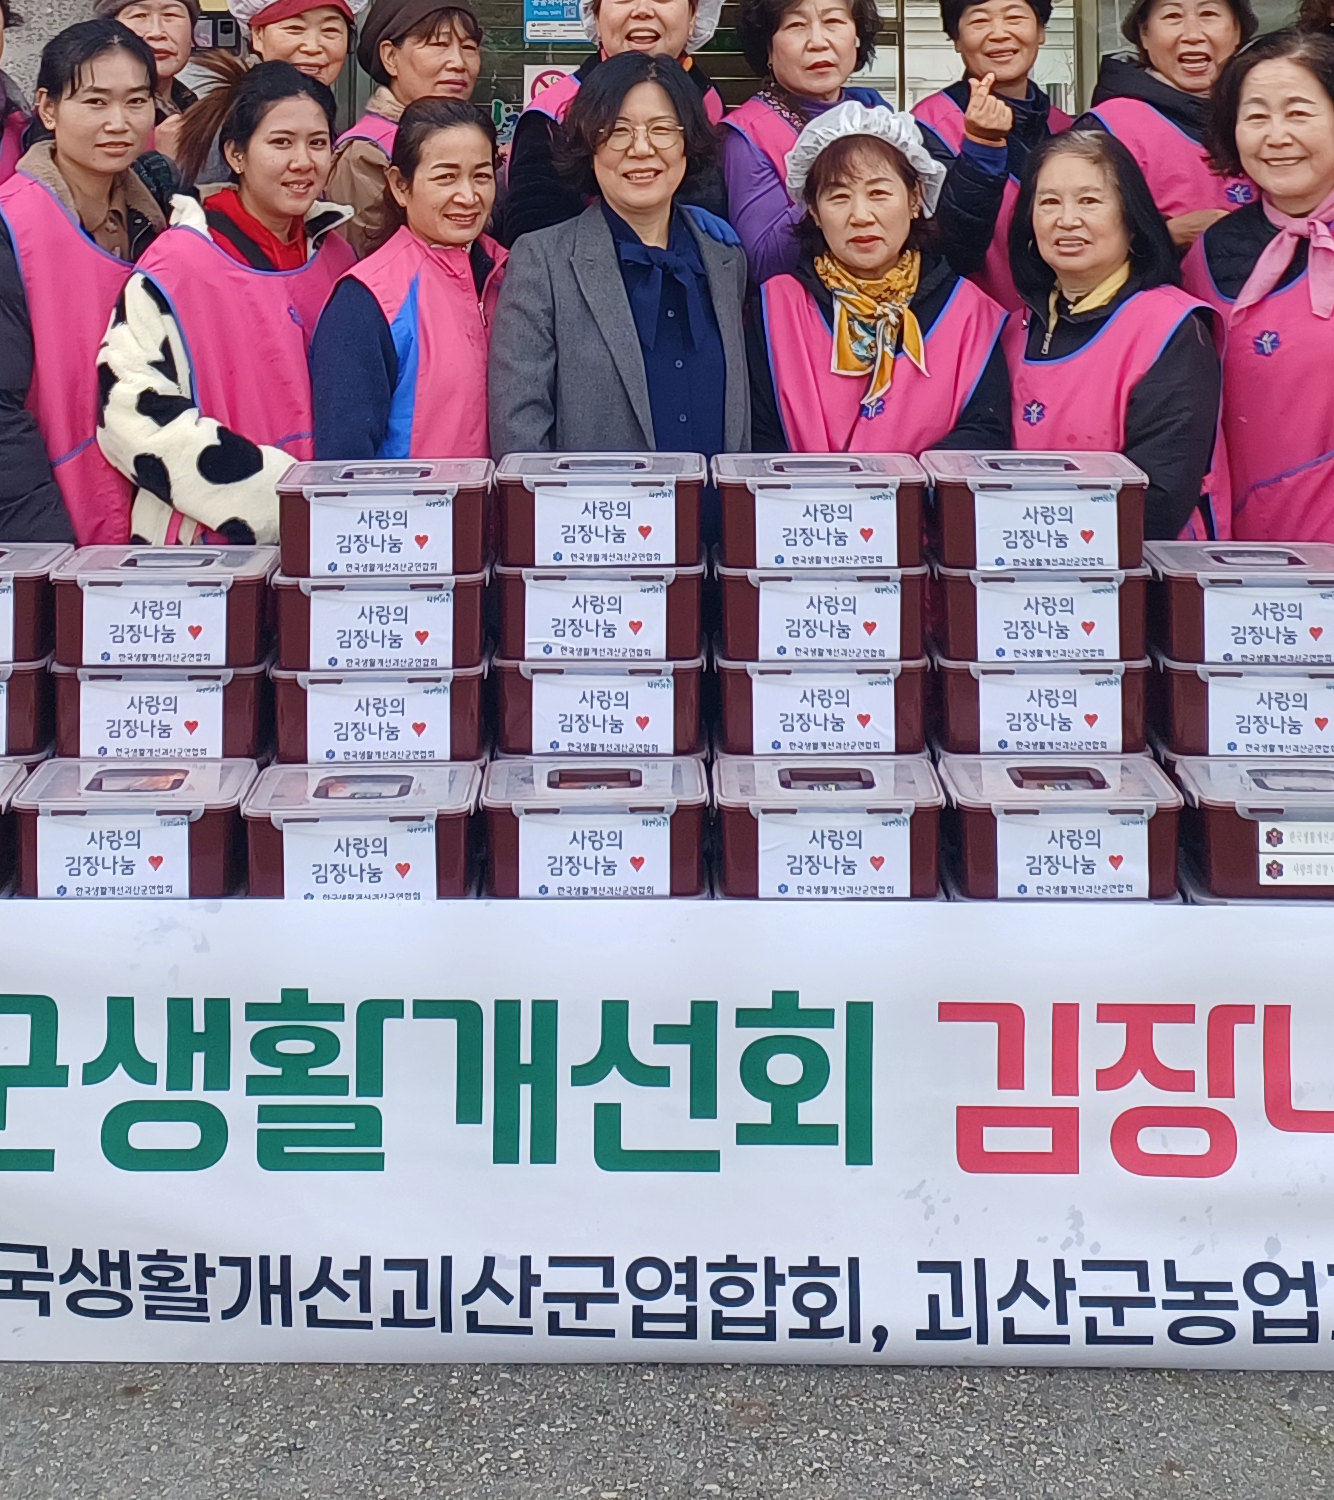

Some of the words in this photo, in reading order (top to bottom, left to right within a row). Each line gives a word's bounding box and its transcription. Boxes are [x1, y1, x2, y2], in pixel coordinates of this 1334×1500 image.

[357, 509, 408, 530] 사랑의
[581, 500, 631, 521] 사랑의
[802, 503, 853, 524] 사랑의
[1022, 505, 1074, 526] 사랑의
[335, 533, 404, 555] 김장나눔
[560, 524, 627, 545] 김장나눔
[782, 526, 849, 547] 김장나눔
[1002, 529, 1070, 550] 김장나눔
[129, 599, 182, 621] 사랑의
[357, 604, 409, 626] 사랑의
[571, 594, 622, 615] 사랑의
[805, 594, 857, 616] 사랑의
[1023, 596, 1075, 617] 사랑의
[1251, 602, 1303, 622] 사랑의
[109, 623, 177, 644] 김장나눔
[551, 617, 618, 639] 김장나눔
[785, 618, 852, 640] 김장나눔
[1003, 620, 1071, 641] 김장나눔
[1230, 625, 1298, 646] 김장나눔
[336, 629, 404, 650] 김장나눔
[126, 695, 178, 716] 사랑의
[354, 697, 405, 718] 사랑의
[578, 689, 629, 711] 사랑의
[799, 688, 850, 709] 사랑의
[1026, 688, 1078, 709] 사랑의
[1256, 691, 1308, 712] 사랑의
[105, 718, 173, 739] 김장나눔
[333, 721, 401, 742] 김장나눔
[558, 713, 625, 734] 김장나눔
[779, 712, 846, 733] 김장나눔
[1005, 712, 1073, 733] 김장나눔
[1235, 714, 1304, 735] 김장나눔
[86, 829, 141, 851] 사랑의
[333, 836, 388, 859] 사랑의
[568, 829, 623, 852] 사랑의
[808, 829, 863, 851] 사랑의
[1047, 828, 1101, 851] 사랑의
[64, 855, 136, 877] 김장나눔
[311, 862, 384, 885] 김장나눔
[547, 855, 618, 877] 김장나눔
[786, 854, 858, 876] 김장나눔
[1025, 854, 1097, 876] 김장나눔
